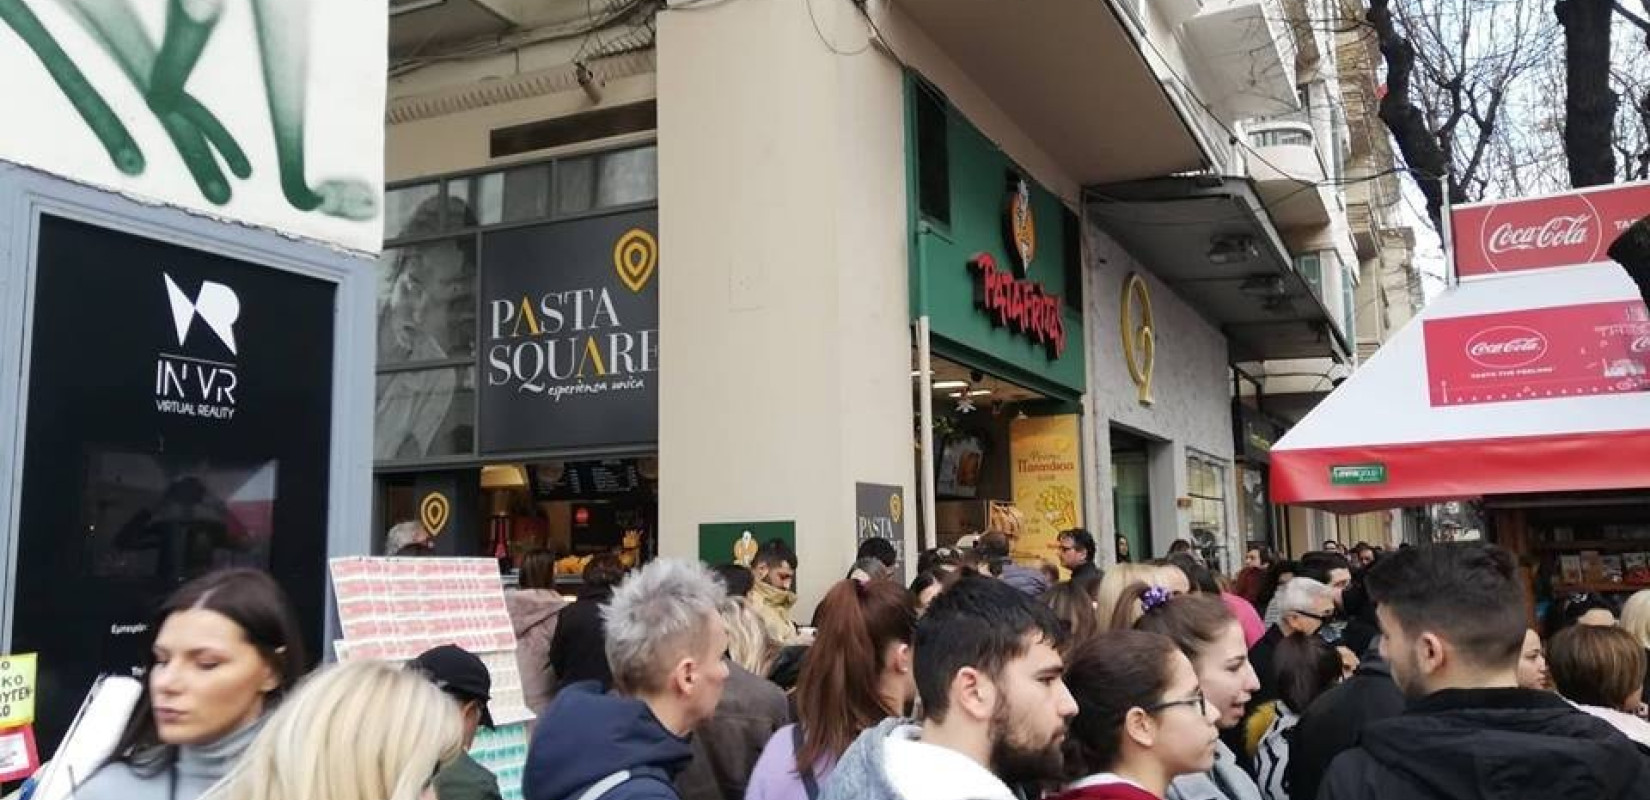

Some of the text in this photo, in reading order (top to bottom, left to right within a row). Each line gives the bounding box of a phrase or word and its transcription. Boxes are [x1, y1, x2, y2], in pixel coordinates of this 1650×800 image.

[1490, 215, 1590, 254] Coca-Cola
[490, 287, 621, 339] PASTA
[488, 329, 659, 393] SQUARE
[197, 365, 237, 405] VR
[156, 400, 235, 419] VIRTUAL REALITY
[858, 516, 894, 539] PASTA
